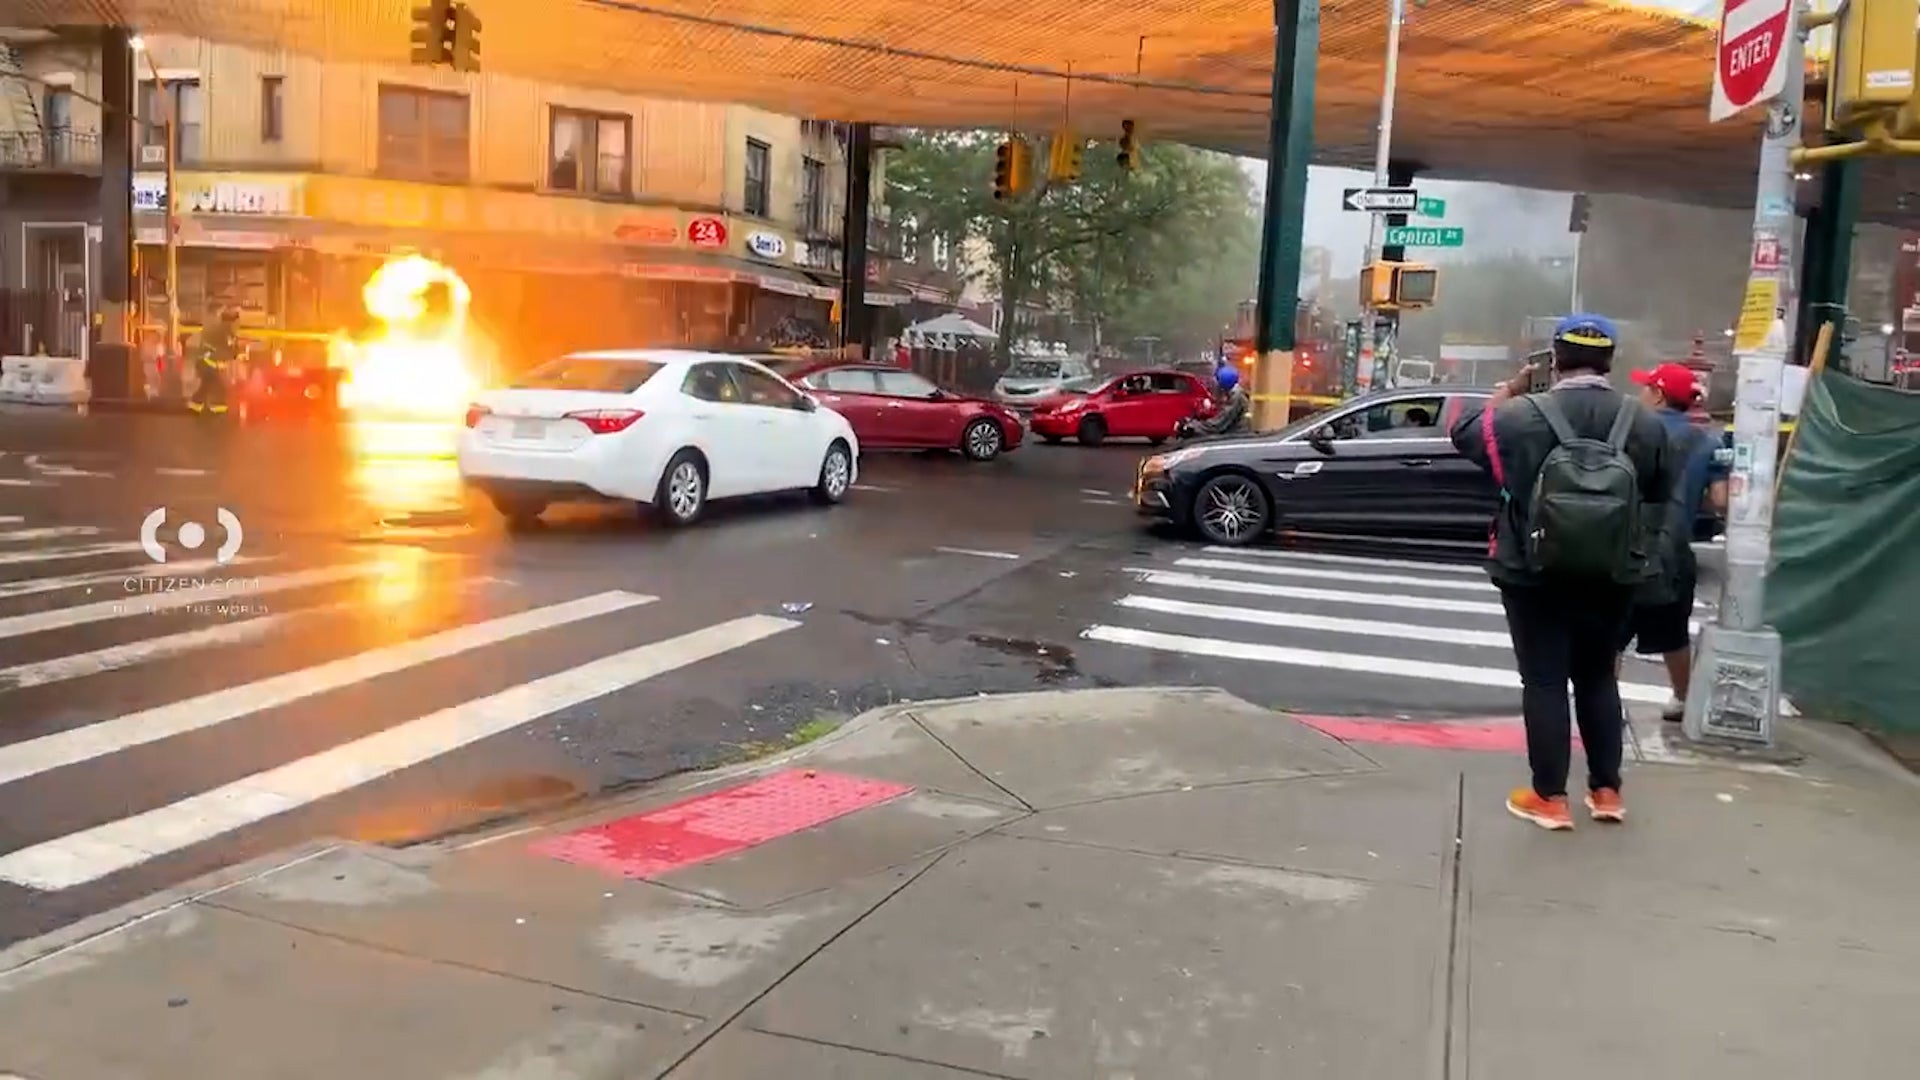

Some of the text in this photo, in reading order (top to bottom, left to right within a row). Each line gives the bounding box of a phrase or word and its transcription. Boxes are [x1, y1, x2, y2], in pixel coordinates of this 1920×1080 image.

[1729, 30, 1773, 77] ENTER
[1386, 195, 1410, 205] WAY
[695, 222, 718, 240] 24
[1389, 228, 1442, 246] Central
